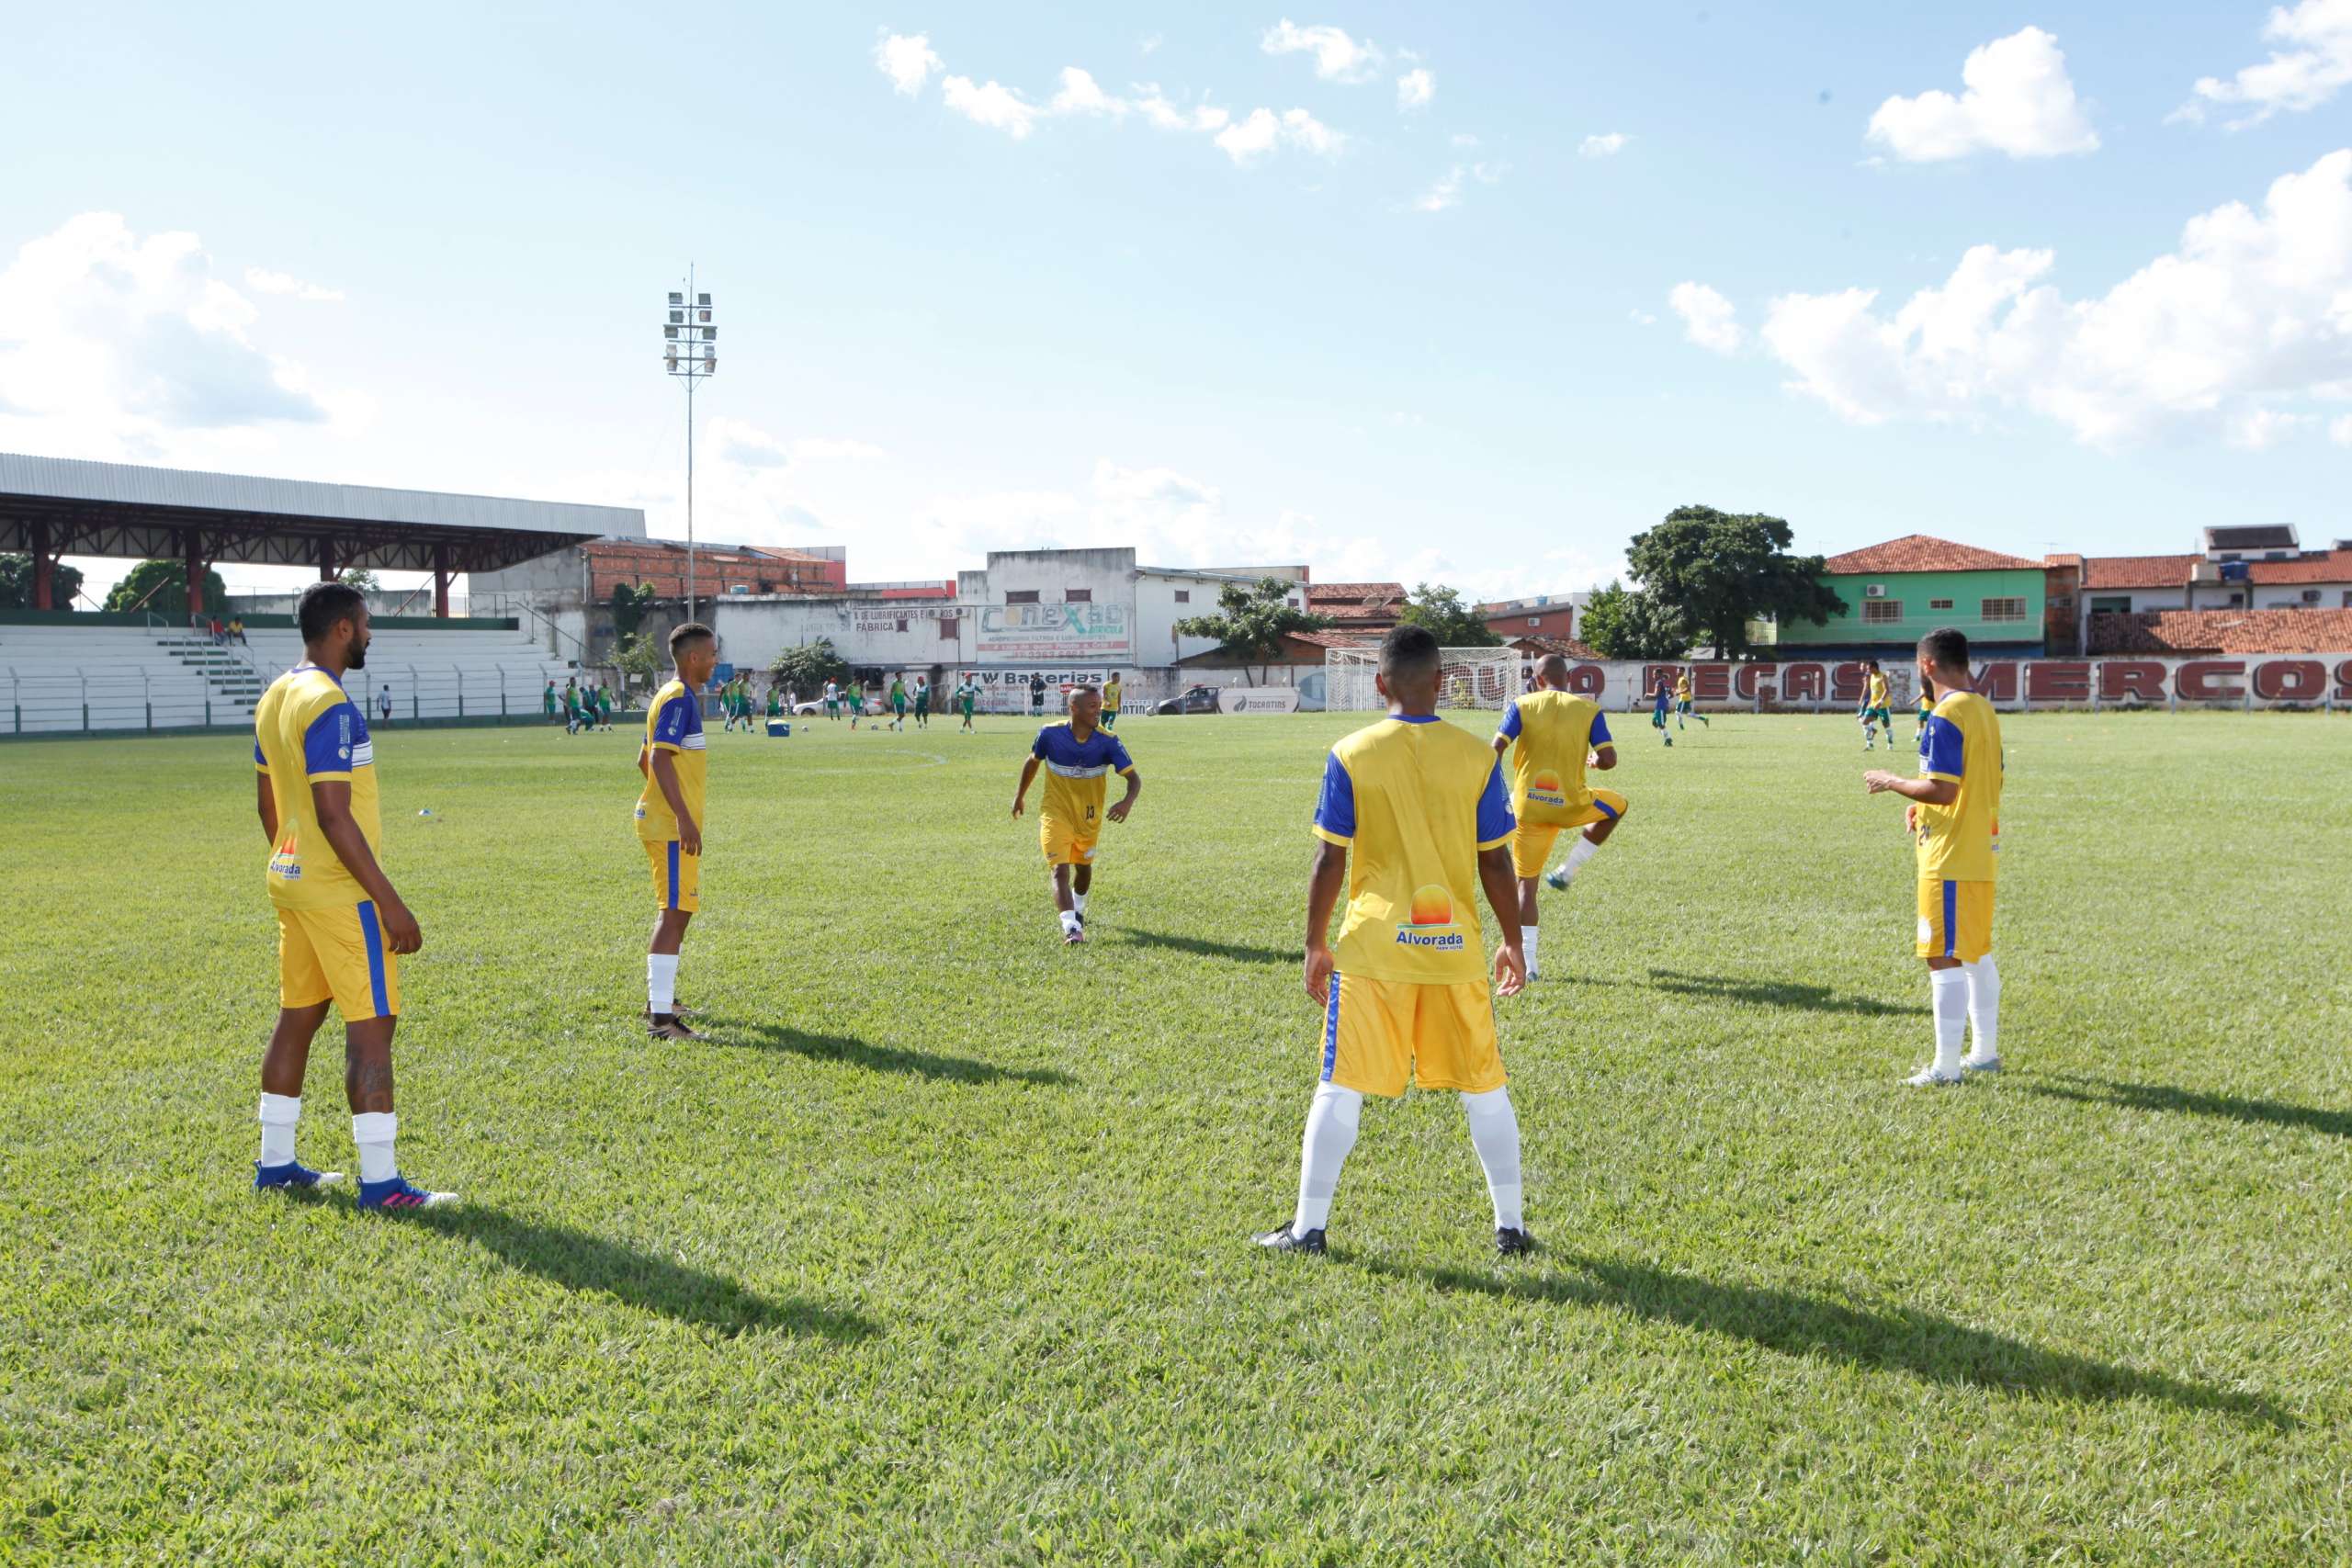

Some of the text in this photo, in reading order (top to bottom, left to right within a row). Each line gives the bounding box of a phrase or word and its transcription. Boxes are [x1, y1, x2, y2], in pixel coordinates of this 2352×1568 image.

[1004, 671, 1102, 684] Baerias
[1967, 660, 2352, 702] MERCO
[1526, 792, 1564, 805] Alvorada
[1396, 931, 1464, 945] Alvorada
